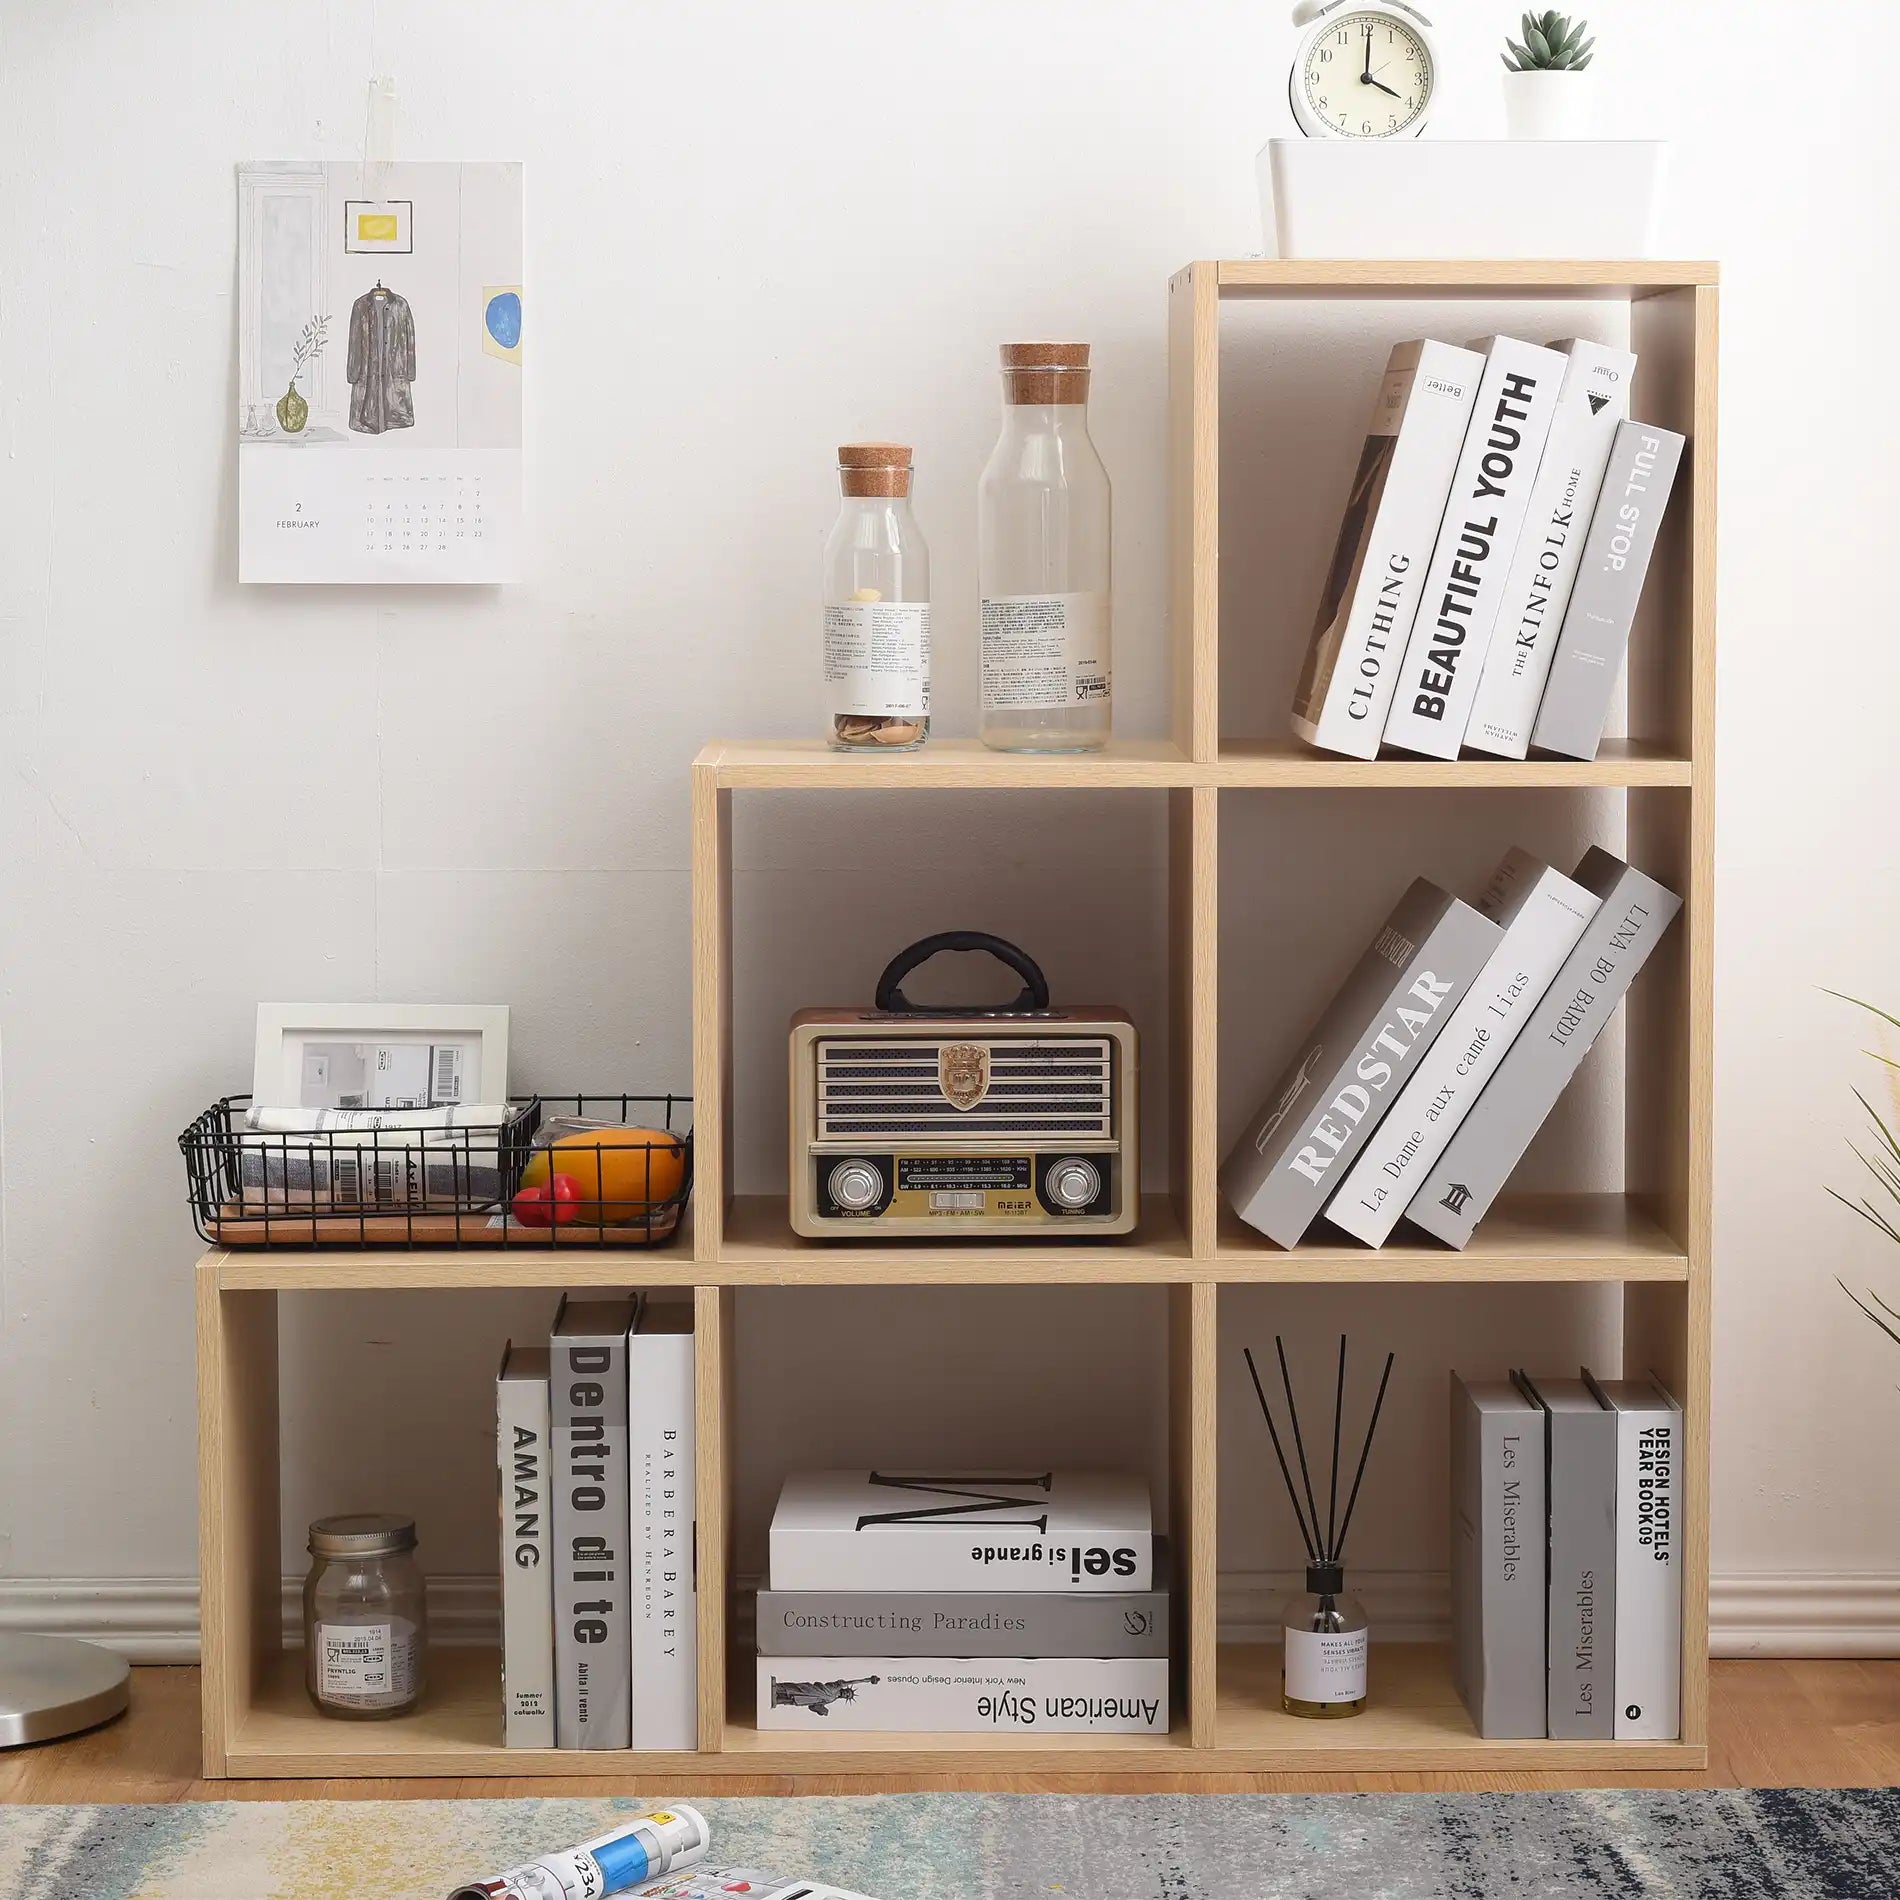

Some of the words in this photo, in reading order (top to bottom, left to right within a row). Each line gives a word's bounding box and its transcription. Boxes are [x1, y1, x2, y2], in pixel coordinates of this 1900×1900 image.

[1338, 32, 1347, 44] 11
[1359, 22, 1375, 38] 12
[1389, 29, 1395, 43] 1
[1321, 50, 1332, 62] 10
[1406, 47, 1415, 60] 2
[1309, 71, 1319, 85] 9
[1415, 71, 1424, 87] 3
[1319, 96, 1327, 108] 8
[1405, 97, 1416, 110] 4
[1339, 114, 1347, 126] 7
[1362, 121, 1371, 134] 6
[1388, 115, 1398, 129] 5
[1625, 434, 1661, 497] FULL
[1562, 468, 1581, 507] HOME
[296, 503, 301, 512] 2
[1411, 514, 1498, 721] BEAUTIFUL
[1471, 371, 1539, 498] YOUTH
[1602, 502, 1641, 574] STOP.
[1516, 505, 1574, 652] KINFOLK
[1347, 551, 1412, 722] CLOTHING
[1512, 651, 1527, 676] THE
[1609, 904, 1649, 949] LINA
[1590, 957, 1615, 983] BO
[1548, 988, 1595, 1048] BARDI
[1287, 969, 1456, 1188] REDSTAR
[1361, 1188, 1388, 1212] La
[1383, 1131, 1426, 1180] Dame
[1426, 1085, 1455, 1121] aux
[1457, 1028, 1492, 1078] camé
[1488, 973, 1531, 1020] lias
[569, 1347, 611, 1511] Dentro
[1504, 1437, 1519, 1468] Les
[1639, 1428, 1654, 1471] YEAR
[1653, 1428, 1670, 1488] DESIGN
[514, 1426, 539, 1567] AMANG
[646, 1527, 651, 1539] BY
[1504, 1481, 1520, 1581] Miserables
[572, 1537, 614, 1581] di
[972, 1544, 1042, 1564] grande
[1050, 1548, 1066, 1565] si
[1072, 1548, 1137, 1583] sei
[574, 1600, 612, 1643] te
[784, 1612, 921, 1632] Constructing
[934, 1613, 1024, 1630] Paradies
[1576, 1571, 1593, 1669] Miserables
[1320, 1640, 1342, 1648] MAKES
[1344, 1639, 1354, 1647] ALL
[1323, 1648, 1346, 1656] SENSES
[887, 1675, 920, 1685] Opuses
[921, 1675, 951, 1685] Design
[953, 1676, 983, 1685] Interior
[985, 1677, 1005, 1686] York
[1007, 1677, 1026, 1686] New
[579, 1699, 588, 1722] vento
[978, 1690, 1036, 1723] Style
[1046, 1698, 1159, 1725] American
[1576, 1684, 1592, 1715] Les
